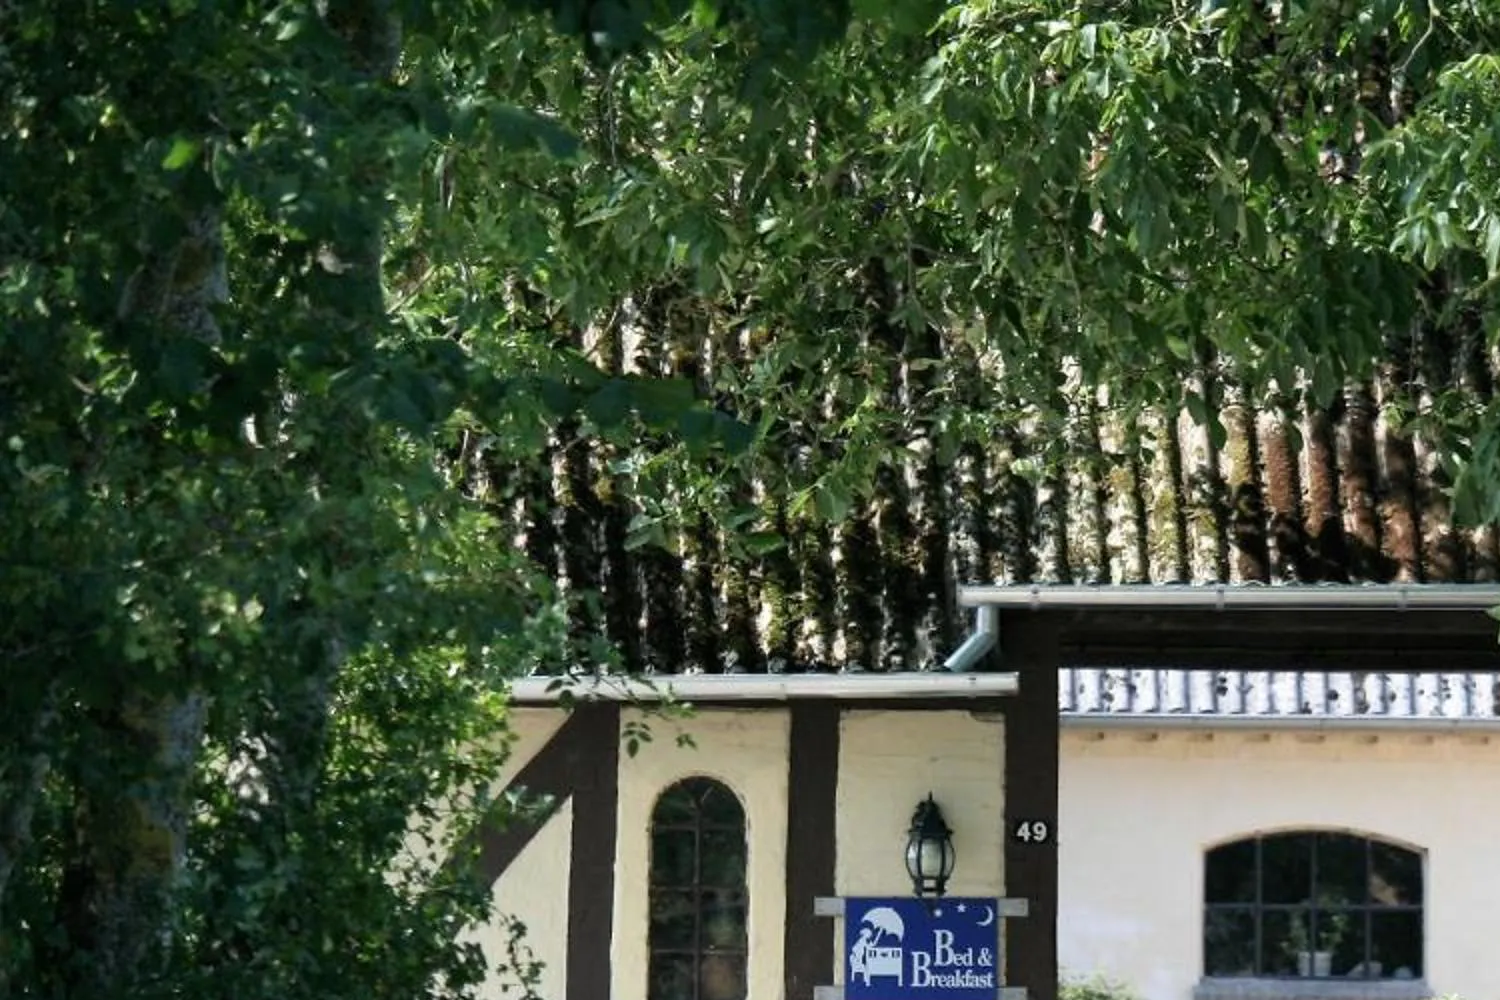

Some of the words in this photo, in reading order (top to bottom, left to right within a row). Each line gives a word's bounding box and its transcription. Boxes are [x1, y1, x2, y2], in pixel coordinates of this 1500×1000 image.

[1016, 821, 1047, 842] 49
[933, 929, 973, 967] Bed
[977, 948, 993, 967] &
[910, 951, 993, 988] Breakfast
